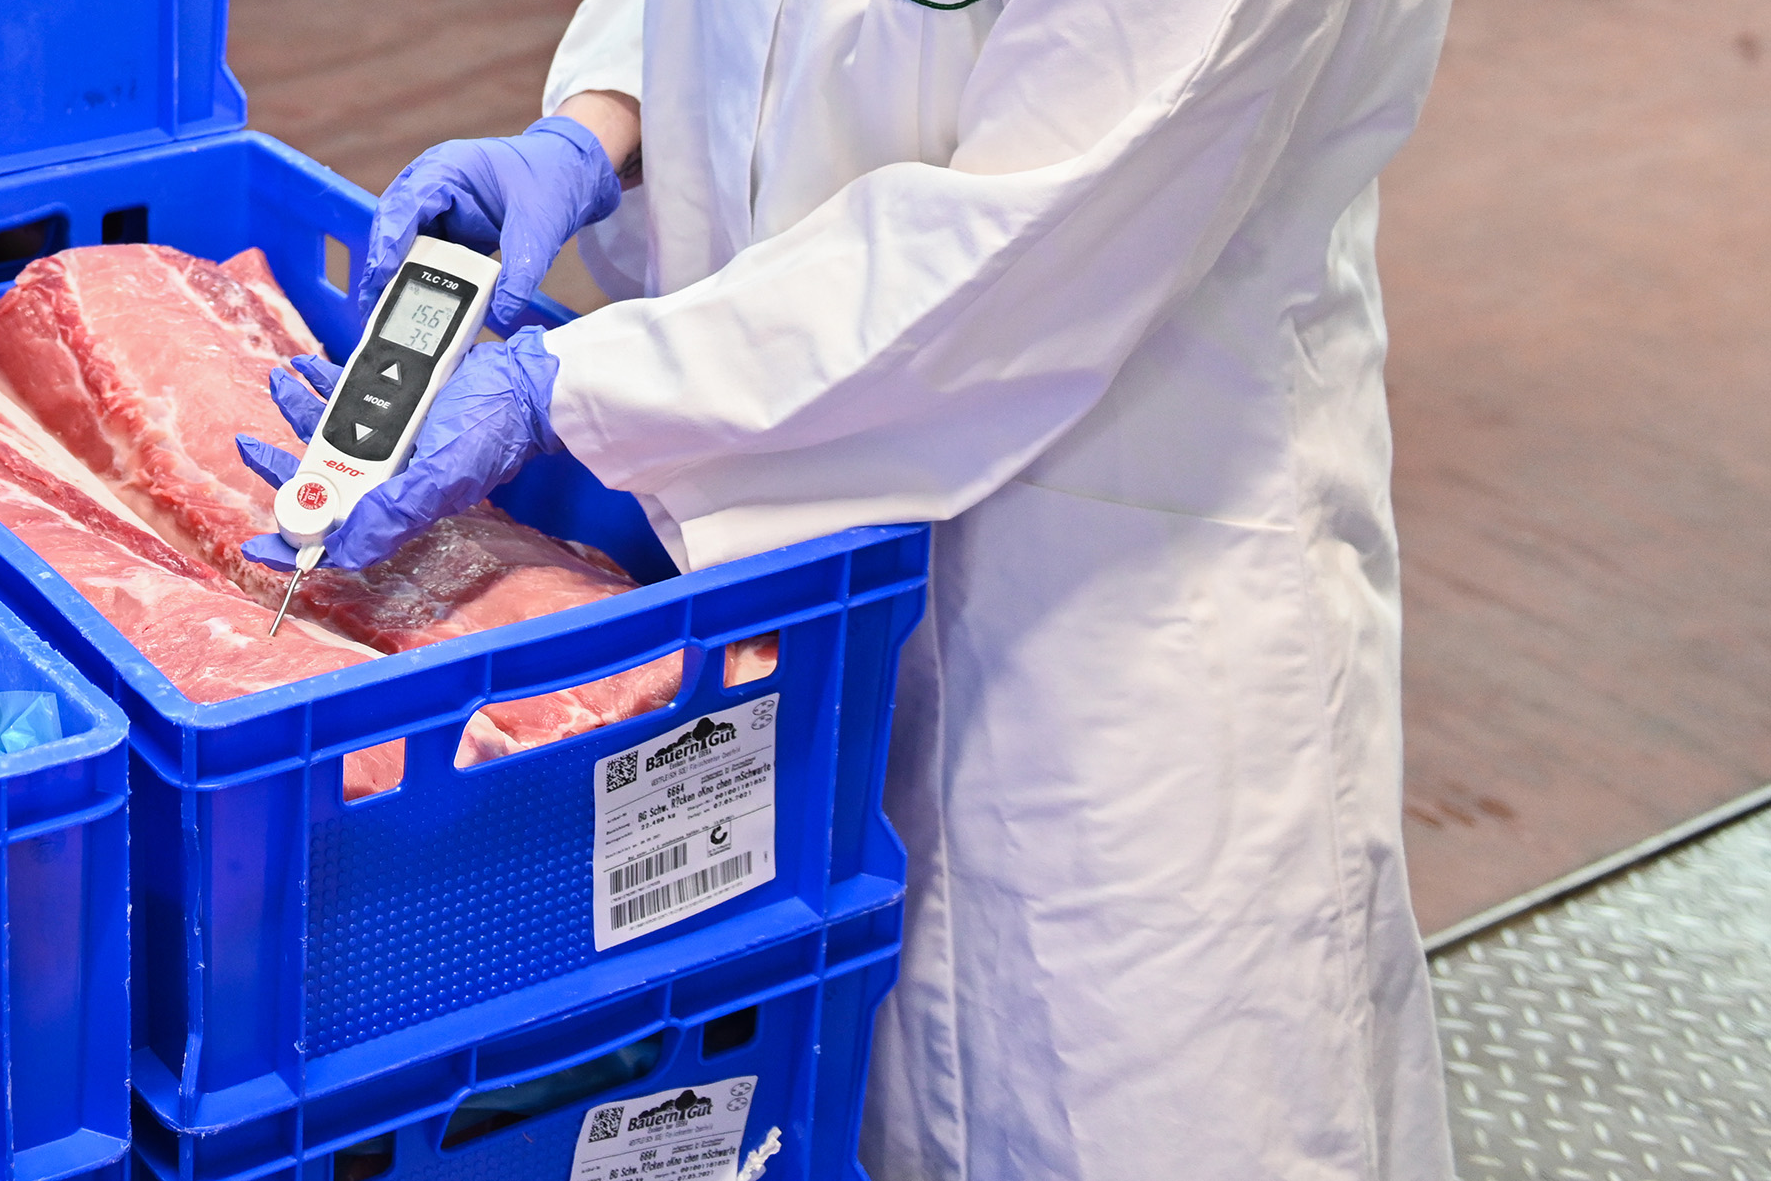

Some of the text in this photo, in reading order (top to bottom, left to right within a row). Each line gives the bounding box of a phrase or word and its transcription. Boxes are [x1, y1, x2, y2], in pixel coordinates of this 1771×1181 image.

[421, 271, 459, 290] TLC 730
[363, 393, 392, 410] MODE
[646, 742, 700, 772] Bauern
[709, 729, 737, 747] Gut
[638, 811, 647, 823] BG
[650, 805, 668, 818] Schw.
[716, 777, 732, 790] chen
[628, 1103, 713, 1132] Bauern Gut
[609, 1169, 620, 1180] BG
